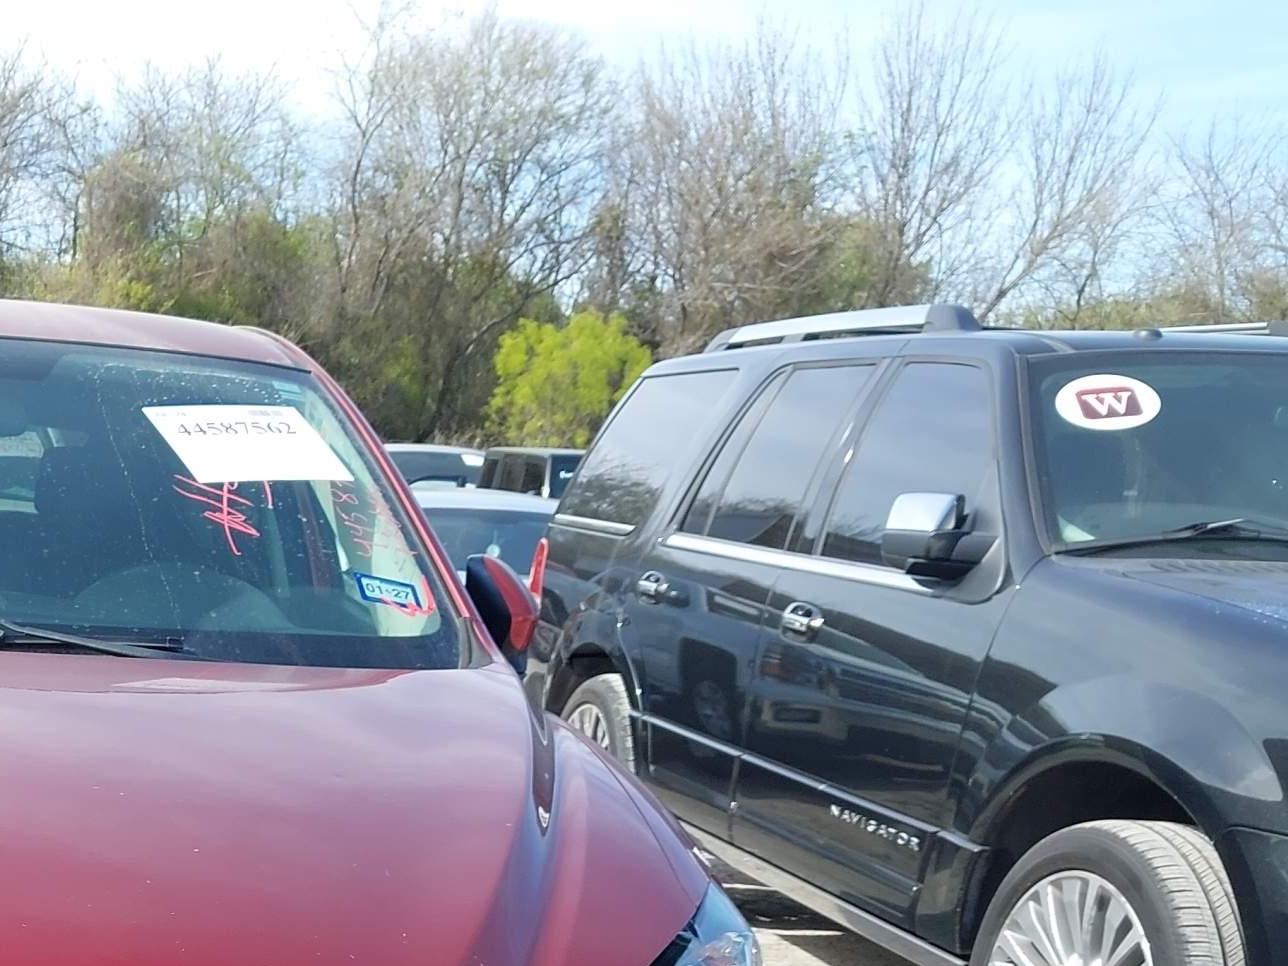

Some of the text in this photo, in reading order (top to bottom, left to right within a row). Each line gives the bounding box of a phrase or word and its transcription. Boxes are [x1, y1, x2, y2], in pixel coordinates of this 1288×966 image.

[1081, 390, 1132, 416] W
[177, 421, 297, 436] 44587562
[829, 803, 920, 852] NAVIGATOR
